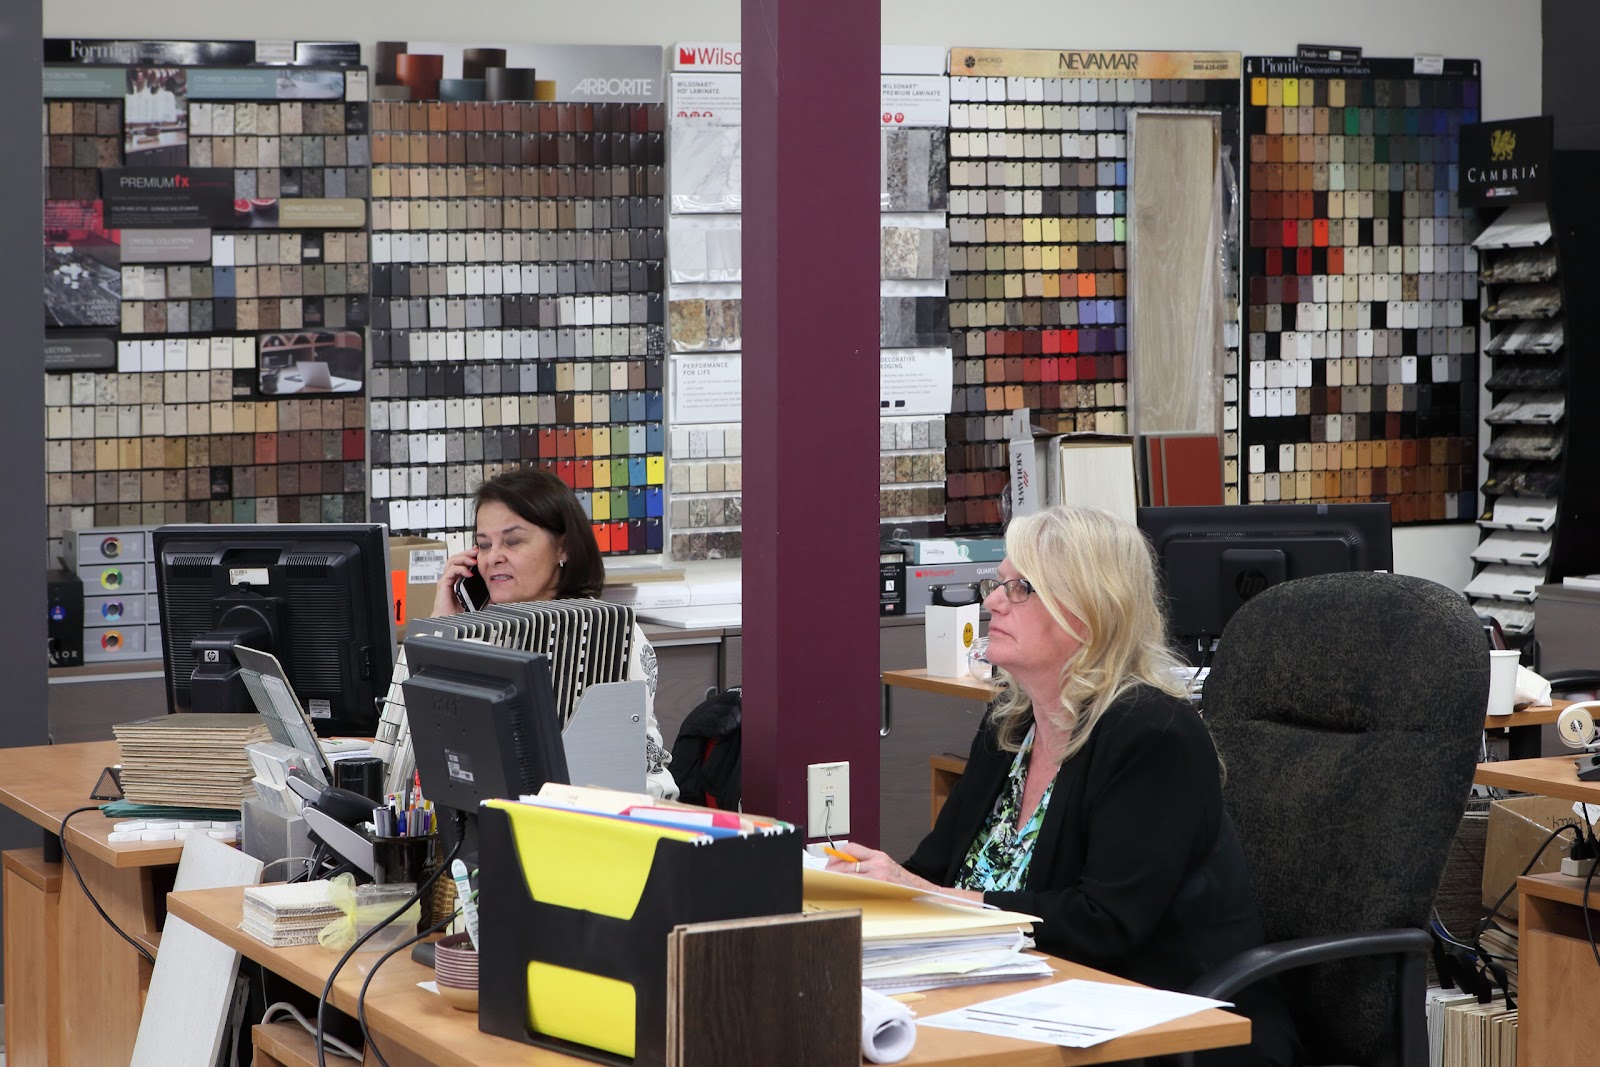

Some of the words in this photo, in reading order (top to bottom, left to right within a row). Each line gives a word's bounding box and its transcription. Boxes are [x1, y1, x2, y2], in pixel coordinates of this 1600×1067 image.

[697, 47, 741, 66] Wilso
[1058, 52, 1138, 70] NEVAMAR
[1304, 65, 1340, 74] Decorative
[1343, 66, 1371, 74] Surfaces
[570, 77, 653, 96] ARBORITE
[1467, 167, 1537, 183] CAMBRIA
[1015, 452, 1025, 507] MOHAWK
